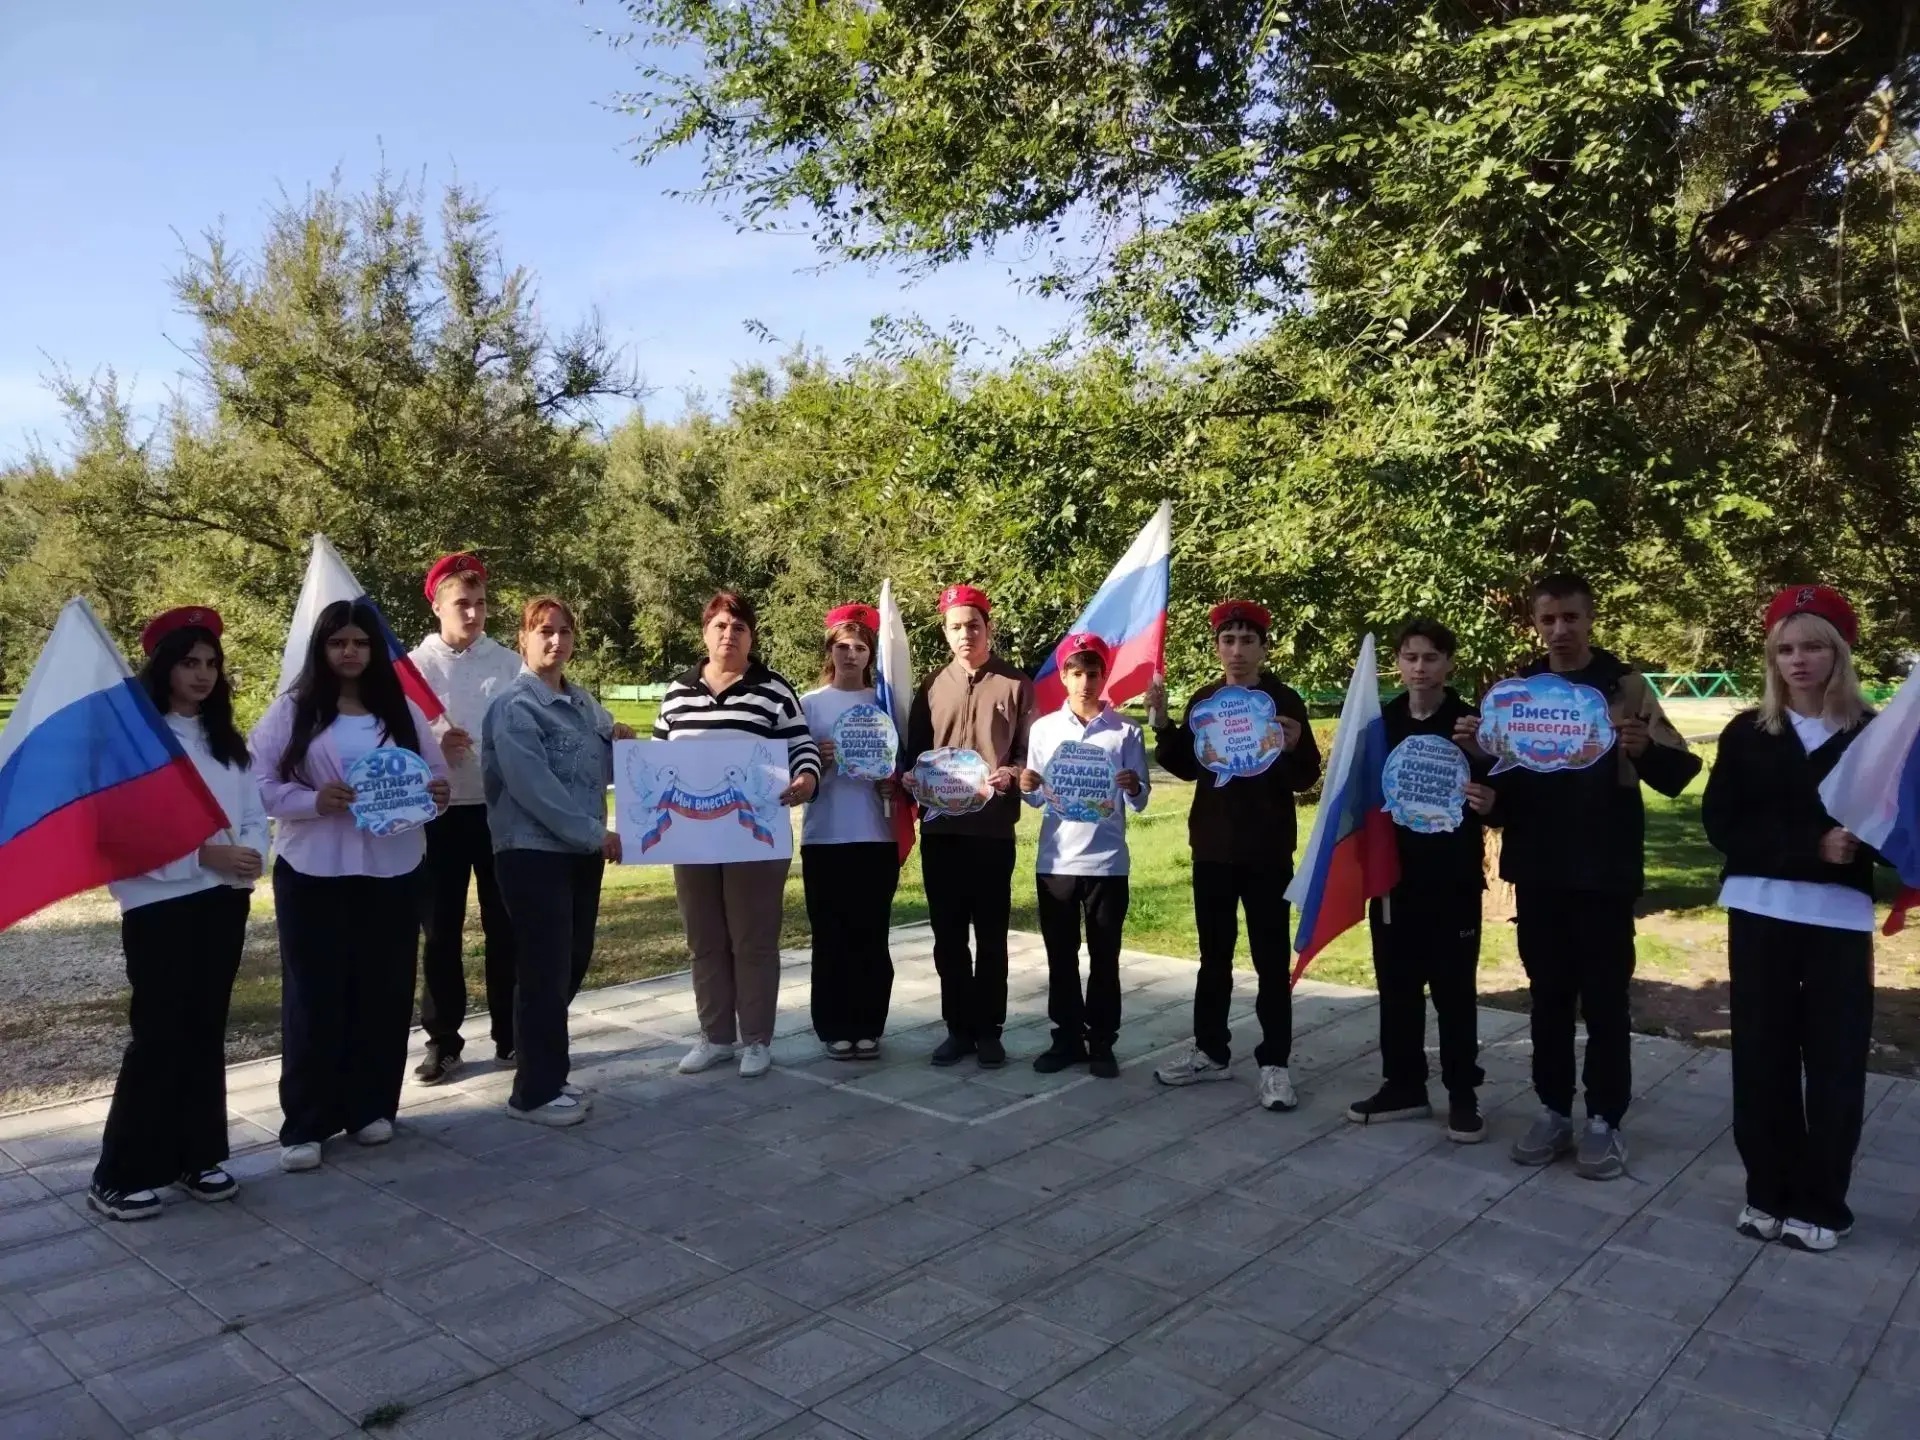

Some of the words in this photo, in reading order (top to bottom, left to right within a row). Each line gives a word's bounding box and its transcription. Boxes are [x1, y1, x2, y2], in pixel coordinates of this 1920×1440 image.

[852, 704, 875, 717] 30
[1221, 699, 1245, 709] Одна
[1218, 705, 1251, 719] страна!
[1512, 702, 1581, 721] Вместе
[1223, 723, 1253, 735] семья!
[1224, 717, 1248, 728] Одна
[1507, 721, 1587, 736] навсегда!
[841, 739, 889, 749] БУДУЩЕЕ
[1228, 735, 1252, 745] Одна
[1407, 738, 1425, 751] 30
[844, 749, 882, 758] ВМЕСТЕ
[1061, 744, 1077, 754] 30
[1225, 741, 1258, 754] Россия!
[366, 751, 407, 778] 30
[1052, 763, 1110, 778] УВАЖАЕМ
[1402, 758, 1458, 779] ПОМНИМ
[355, 773, 424, 793] СЕНТЯБРЯ
[1052, 776, 1111, 789] ТРАДИЦИИ
[1397, 768, 1458, 789] ИСТОРИЮ
[374, 788, 409, 801] ДЕНЬ
[1053, 786, 1077, 797] ДРУГ
[1079, 788, 1107, 799] ДРУГА
[1396, 789, 1451, 808] РЕГИОНОВ
[671, 789, 691, 809] Мы
[695, 788, 736, 811] вместе!
